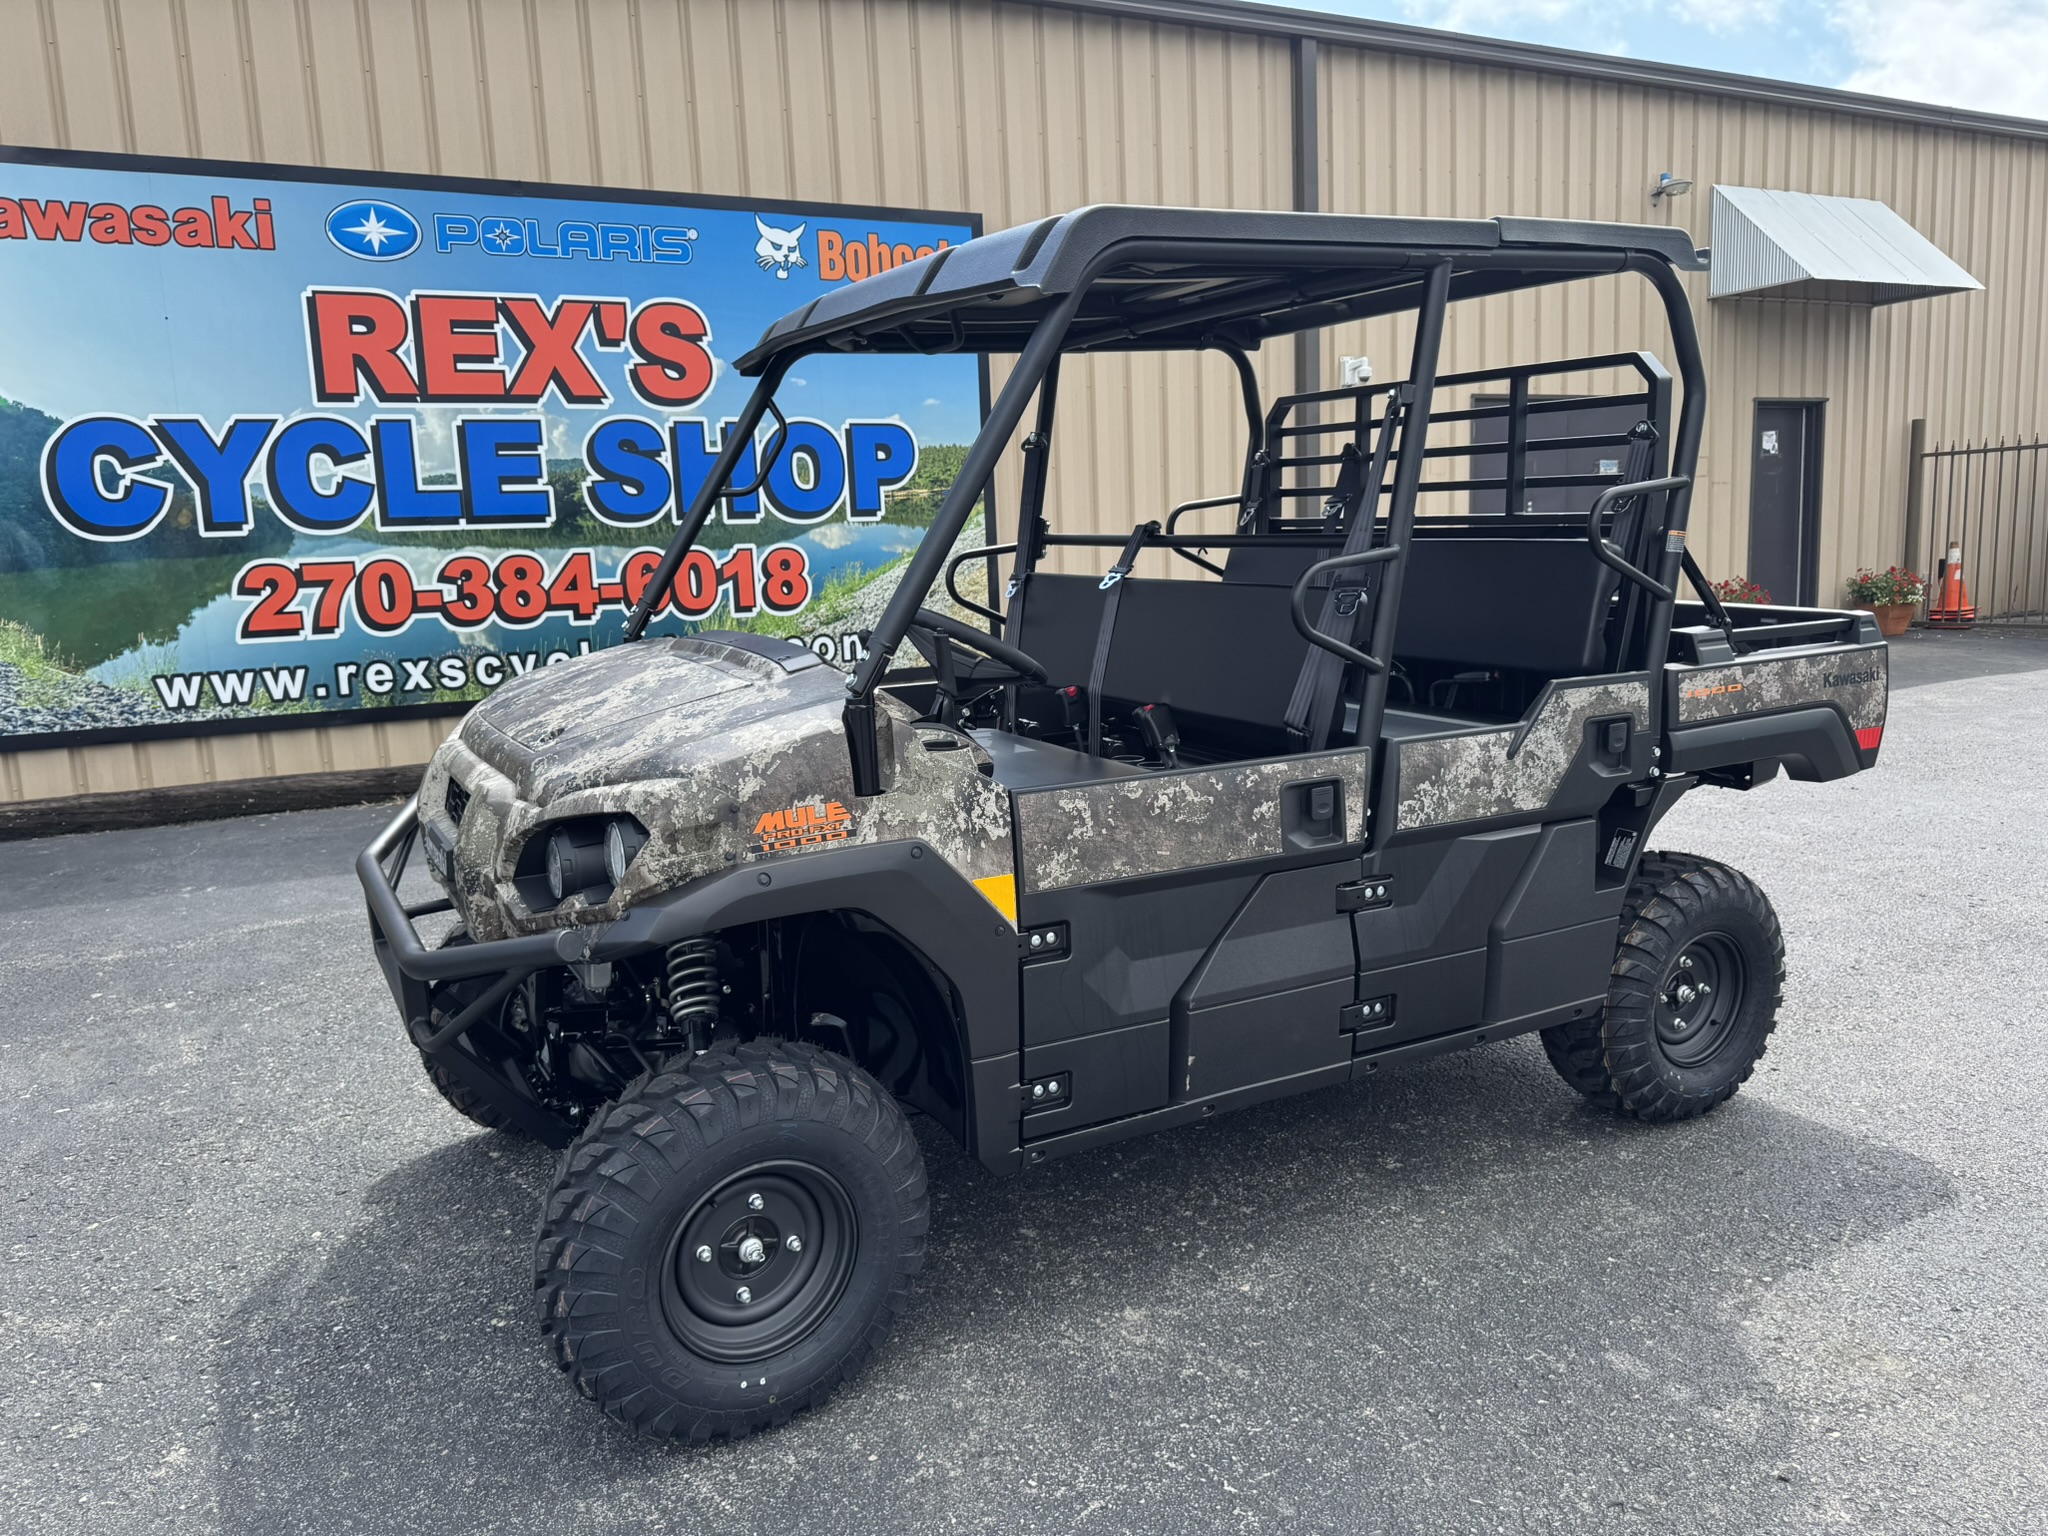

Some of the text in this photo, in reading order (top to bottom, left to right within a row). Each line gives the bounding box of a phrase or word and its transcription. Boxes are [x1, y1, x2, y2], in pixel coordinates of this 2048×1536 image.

[433, 213, 693, 265] POLARIS
[301, 285, 713, 410] REX'S
[40, 411, 919, 543] CYCLE SHOP
[231, 542, 812, 645] 270-384-6018
[1823, 666, 1879, 689] Kawasaki
[753, 801, 852, 834] MULE
[762, 831, 848, 852] 1000
